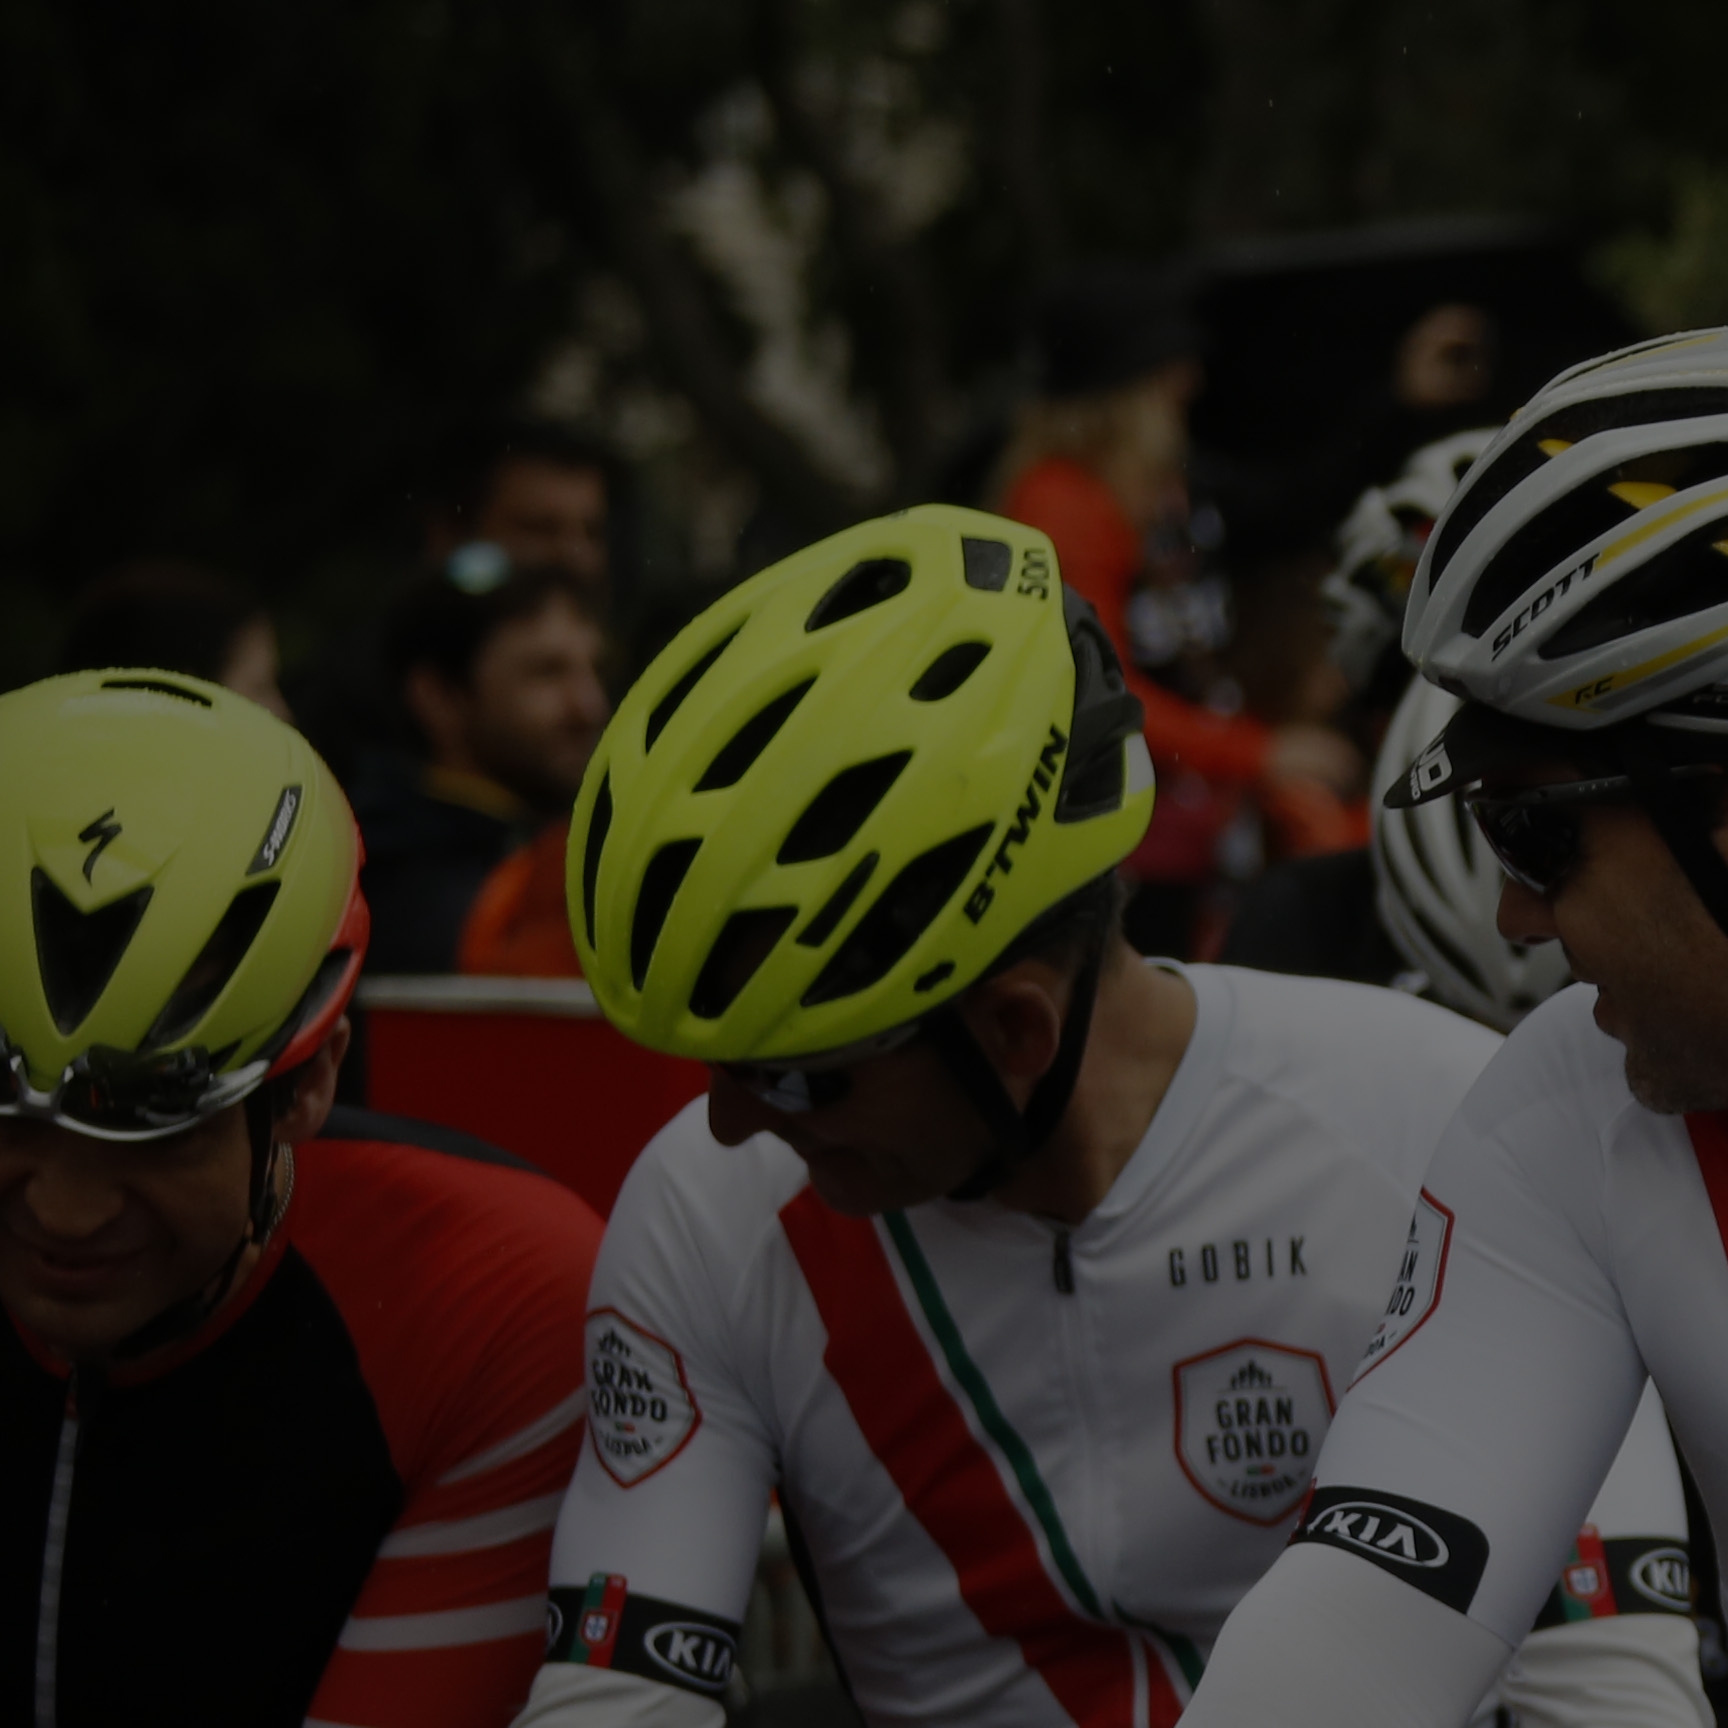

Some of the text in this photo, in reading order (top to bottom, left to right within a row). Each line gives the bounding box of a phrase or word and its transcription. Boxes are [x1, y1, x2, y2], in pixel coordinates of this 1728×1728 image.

[1492, 553, 1600, 662] SCOTT
[1170, 1237, 1307, 1287] GOBIK
[1216, 1397, 1294, 1429] GRAN
[1207, 1430, 1309, 1464] FONDO
[1323, 1510, 1418, 1560] KIA
